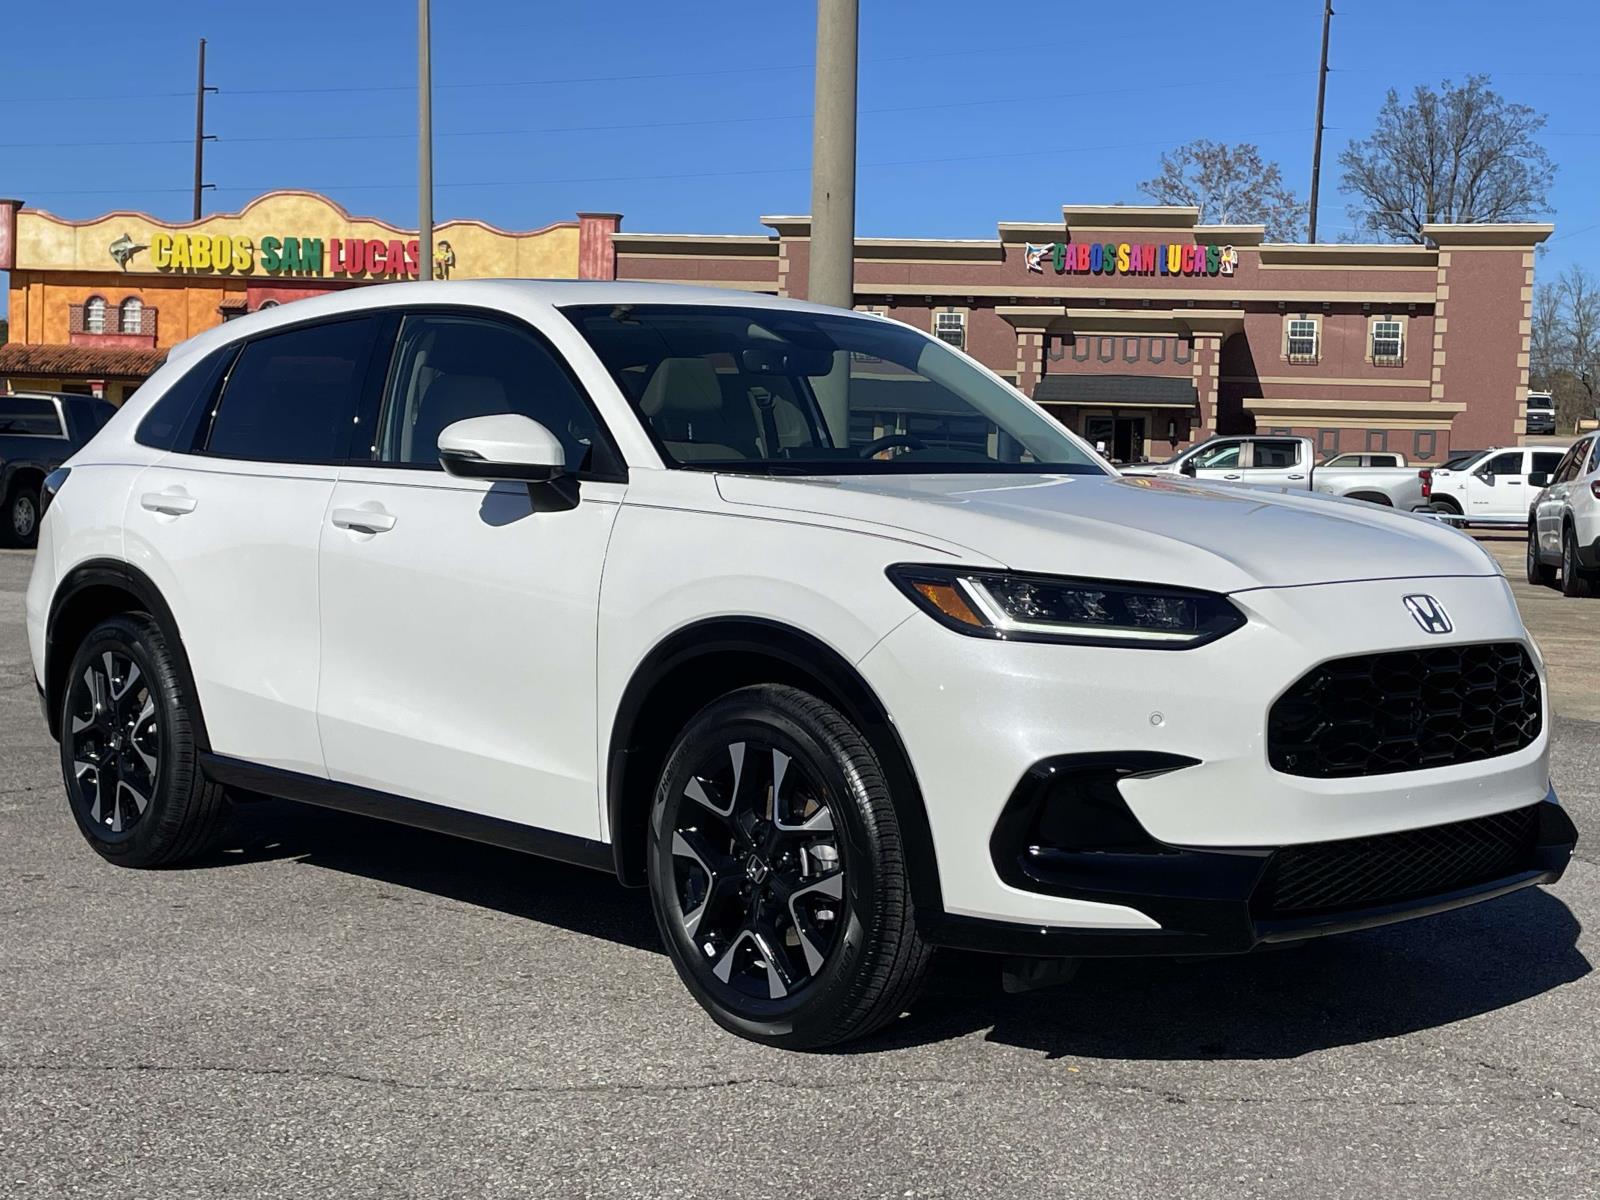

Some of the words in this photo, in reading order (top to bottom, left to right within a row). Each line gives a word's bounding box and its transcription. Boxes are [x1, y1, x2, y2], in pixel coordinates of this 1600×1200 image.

[151, 232, 252, 272] CABOS
[260, 236, 321, 272] SAN
[330, 239, 420, 275] LUCAS
[1052, 243, 1115, 273] CABOS
[1117, 243, 1156, 273] SAN
[1158, 244, 1219, 274] LUCAS
